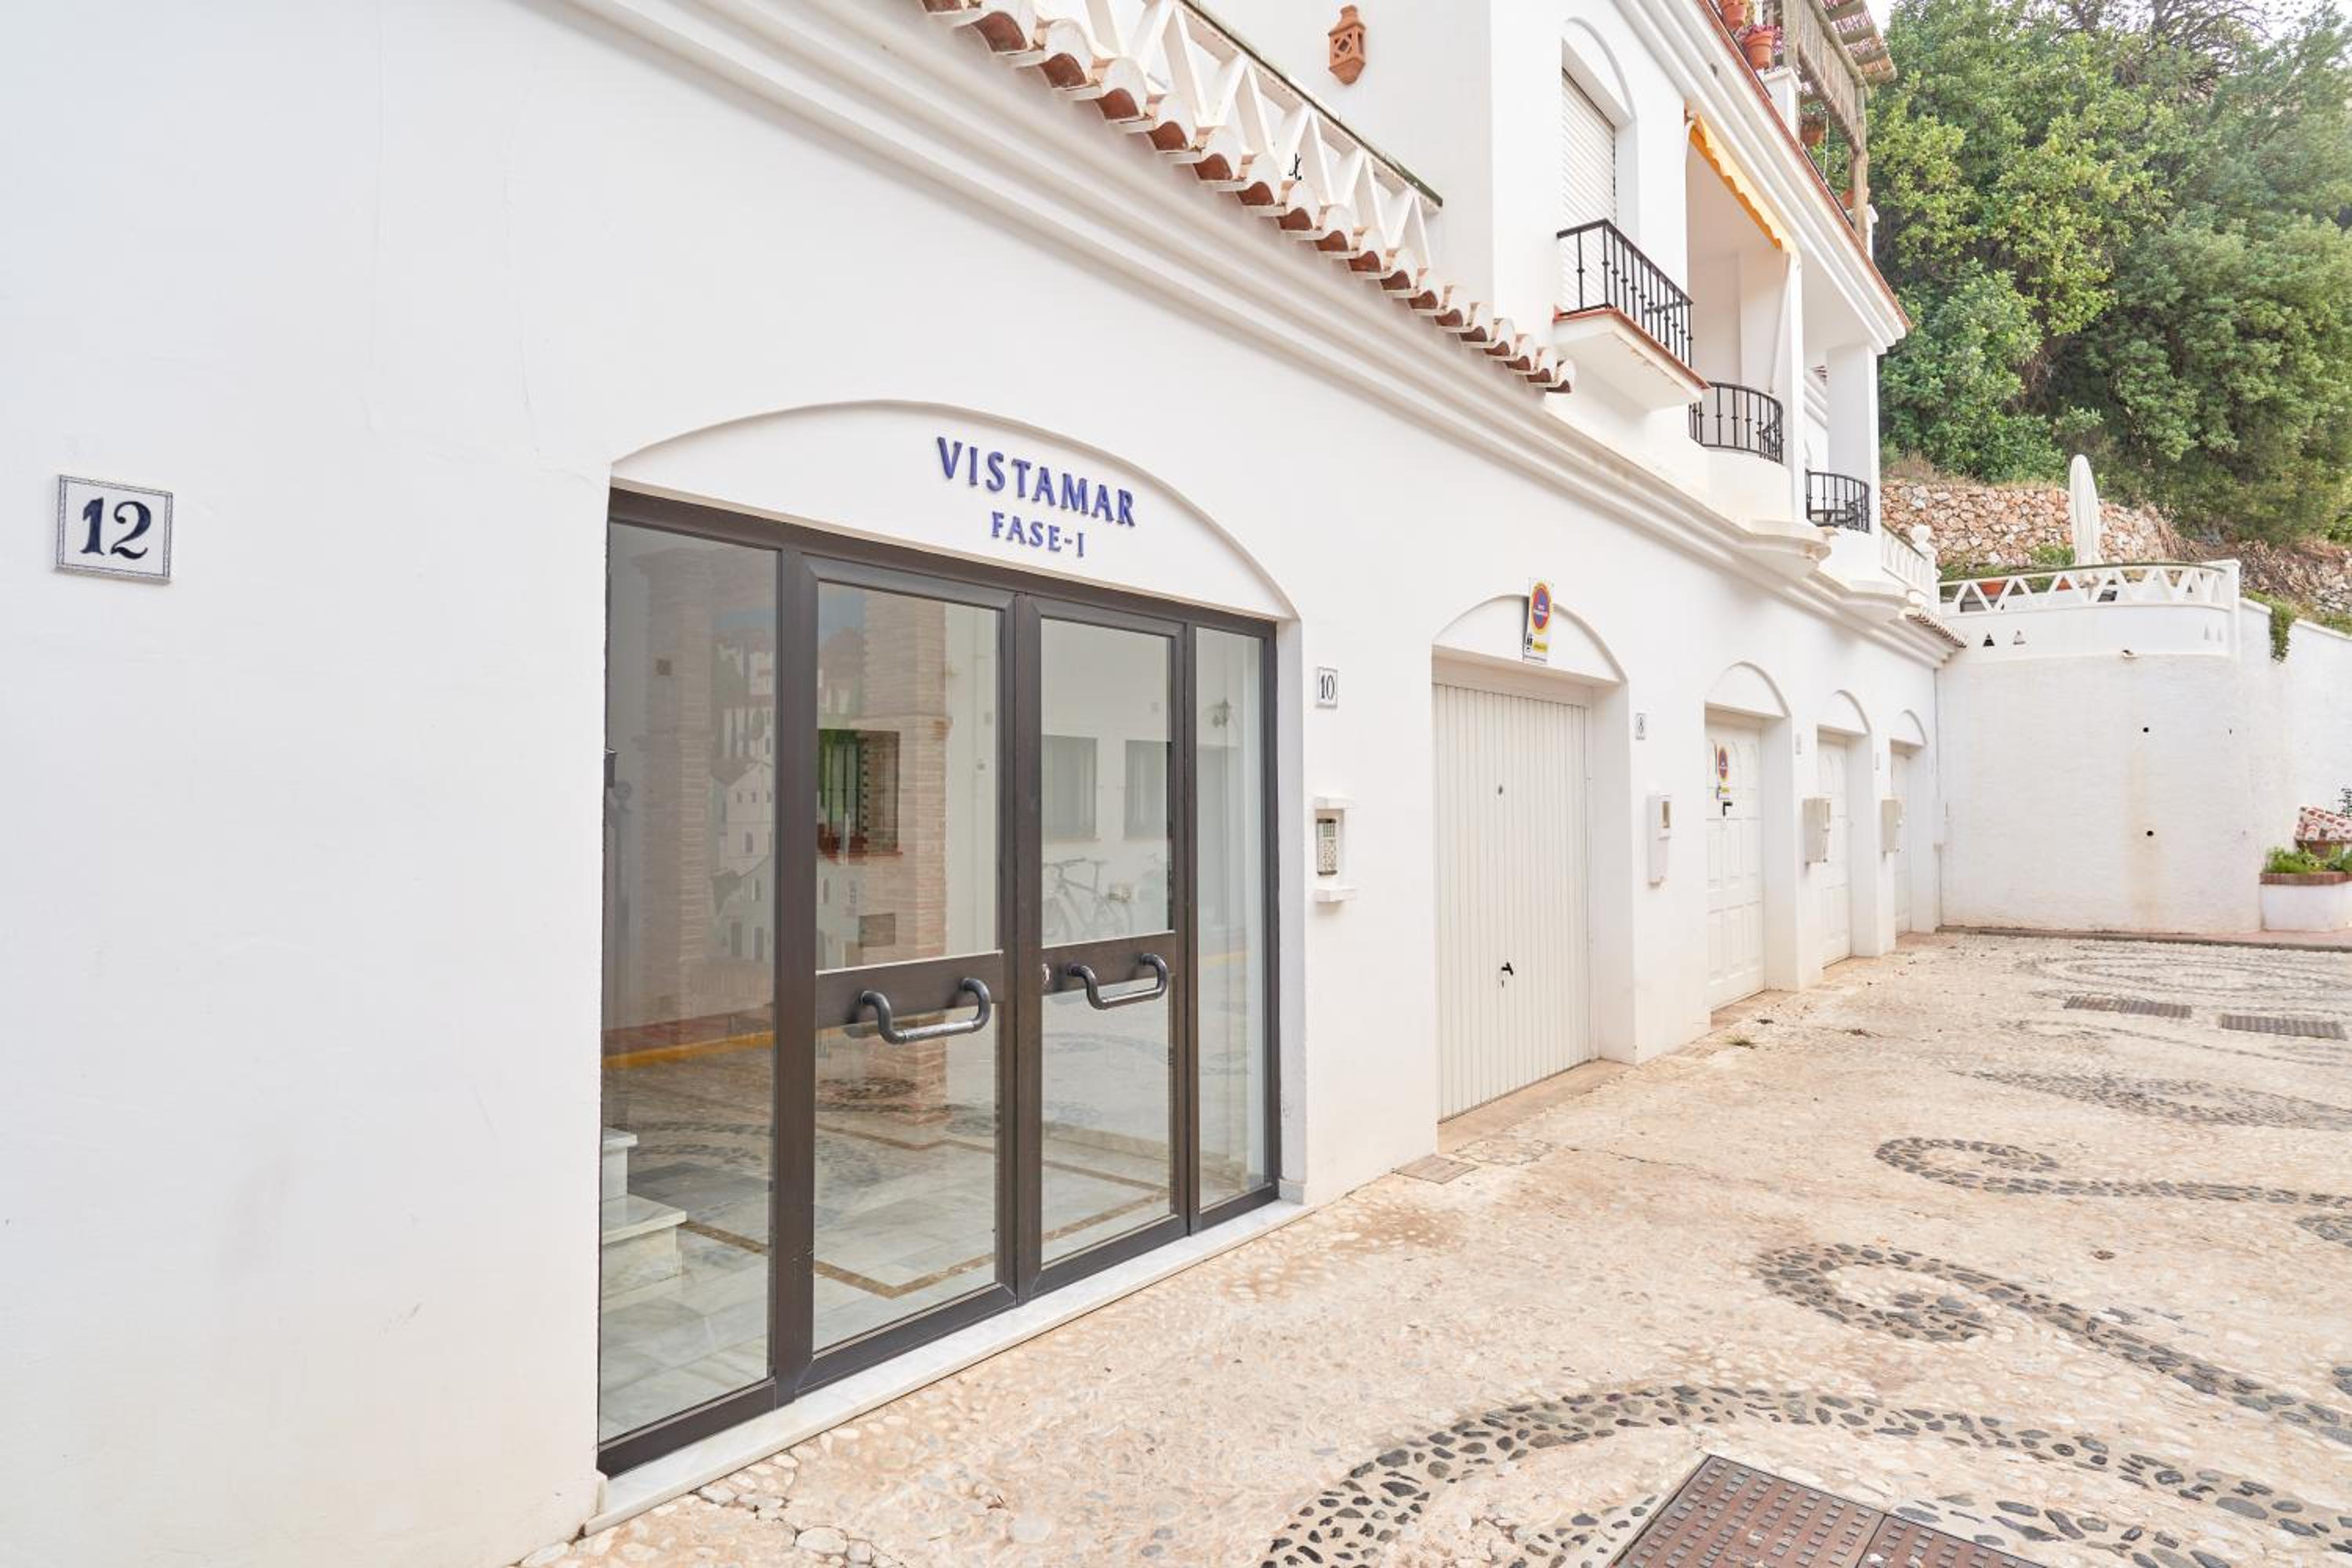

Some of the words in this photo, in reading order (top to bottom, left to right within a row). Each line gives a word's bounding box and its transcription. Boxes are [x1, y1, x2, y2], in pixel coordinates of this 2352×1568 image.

[937, 436, 1135, 528] VISTAMAR
[80, 496, 151, 561] 12
[991, 510, 1084, 558] FASE-I
[1321, 674, 1335, 700] 10
